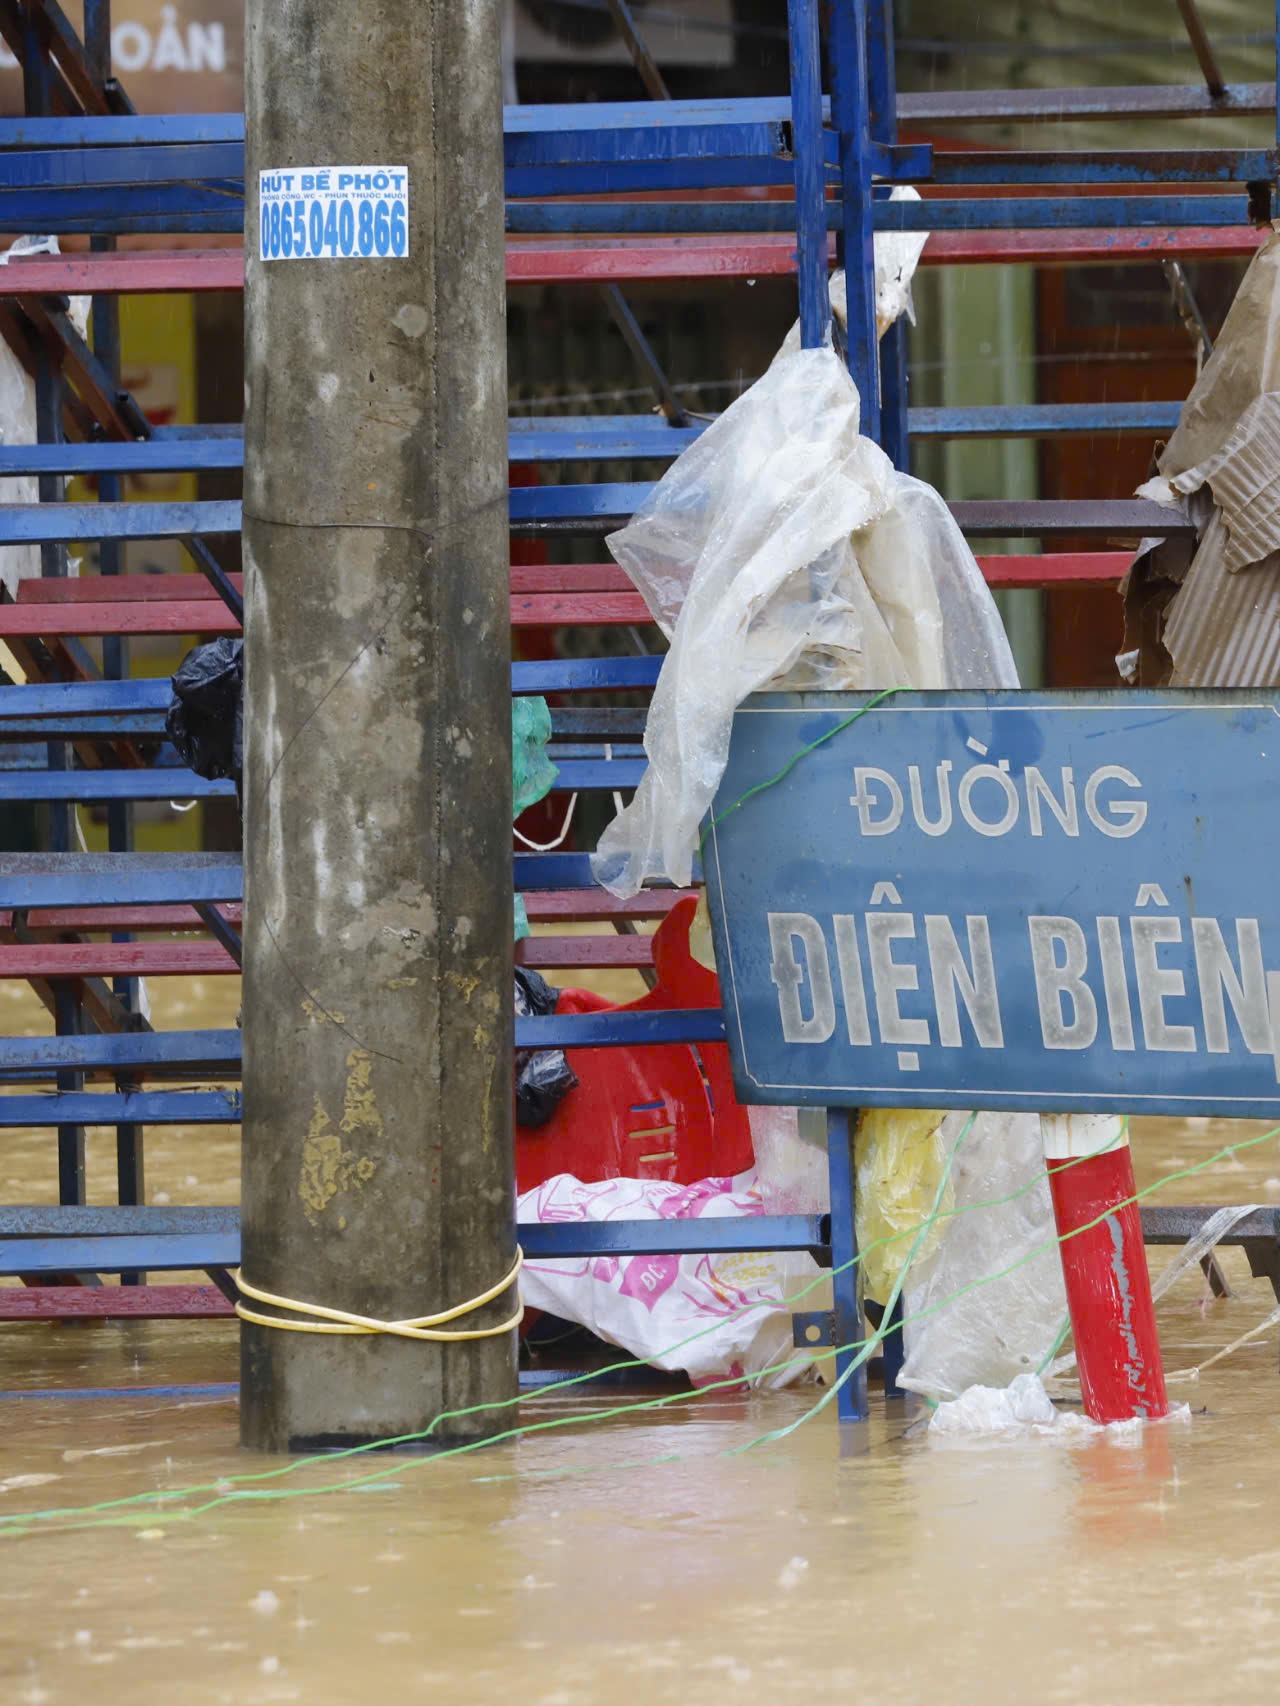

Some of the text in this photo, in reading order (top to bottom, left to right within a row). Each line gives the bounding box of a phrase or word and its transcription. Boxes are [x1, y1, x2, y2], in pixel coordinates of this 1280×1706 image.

[261, 171, 294, 193] HÚT
[338, 169, 406, 191] PHỐT
[262, 199, 406, 258] 0865.040.866
[849, 736, 1148, 839] ĐƯỜNG
[767, 881, 1276, 1071] ĐIỆN BIÊN
